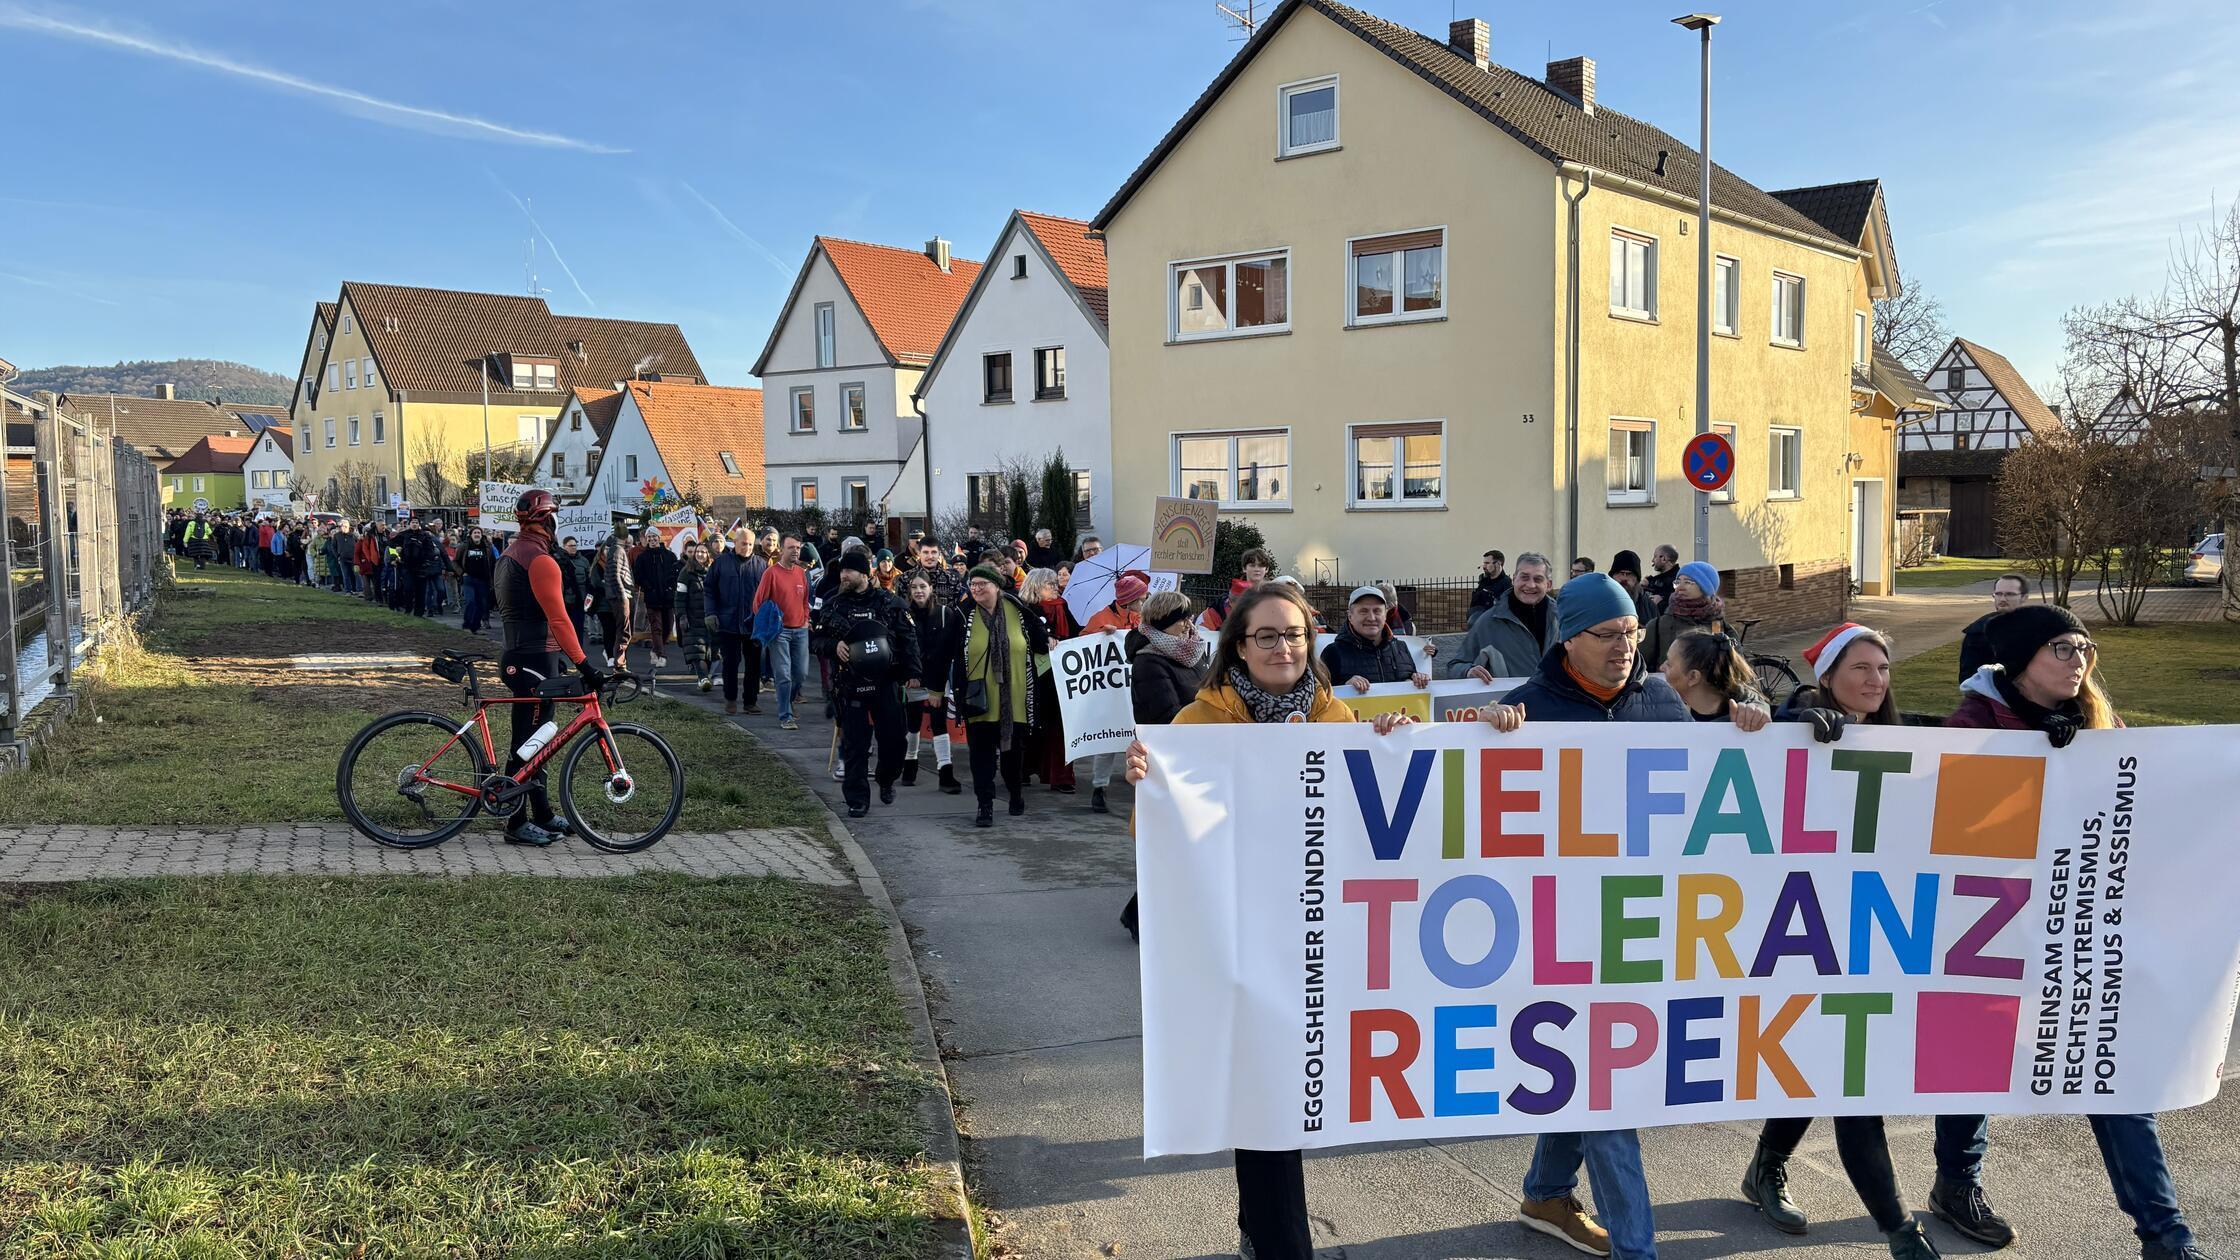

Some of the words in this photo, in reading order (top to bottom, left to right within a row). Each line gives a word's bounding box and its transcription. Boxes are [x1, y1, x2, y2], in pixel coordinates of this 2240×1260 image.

[1523, 414, 1534, 424] 33
[1061, 641, 1132, 675] OMA
[1300, 750, 1325, 798] FÜR
[1343, 749, 1912, 860] VIELFALT
[2106, 756, 2137, 900] RASSISMUS
[1300, 805, 1324, 922] BÜNDNIS
[2104, 907, 2121, 925] &
[1343, 870, 2031, 990] TOLERANZ
[2031, 943, 2063, 1096] GEMEINSAM
[2047, 848, 2071, 935] GEGEN
[2063, 811, 2106, 1095] RECHTSEXTREMISMUS,
[1304, 929, 1324, 1132] EGGOLSHEIMER
[1349, 993, 1893, 1124] RESPEKT
[2095, 934, 2123, 1095] POPULISMUS
